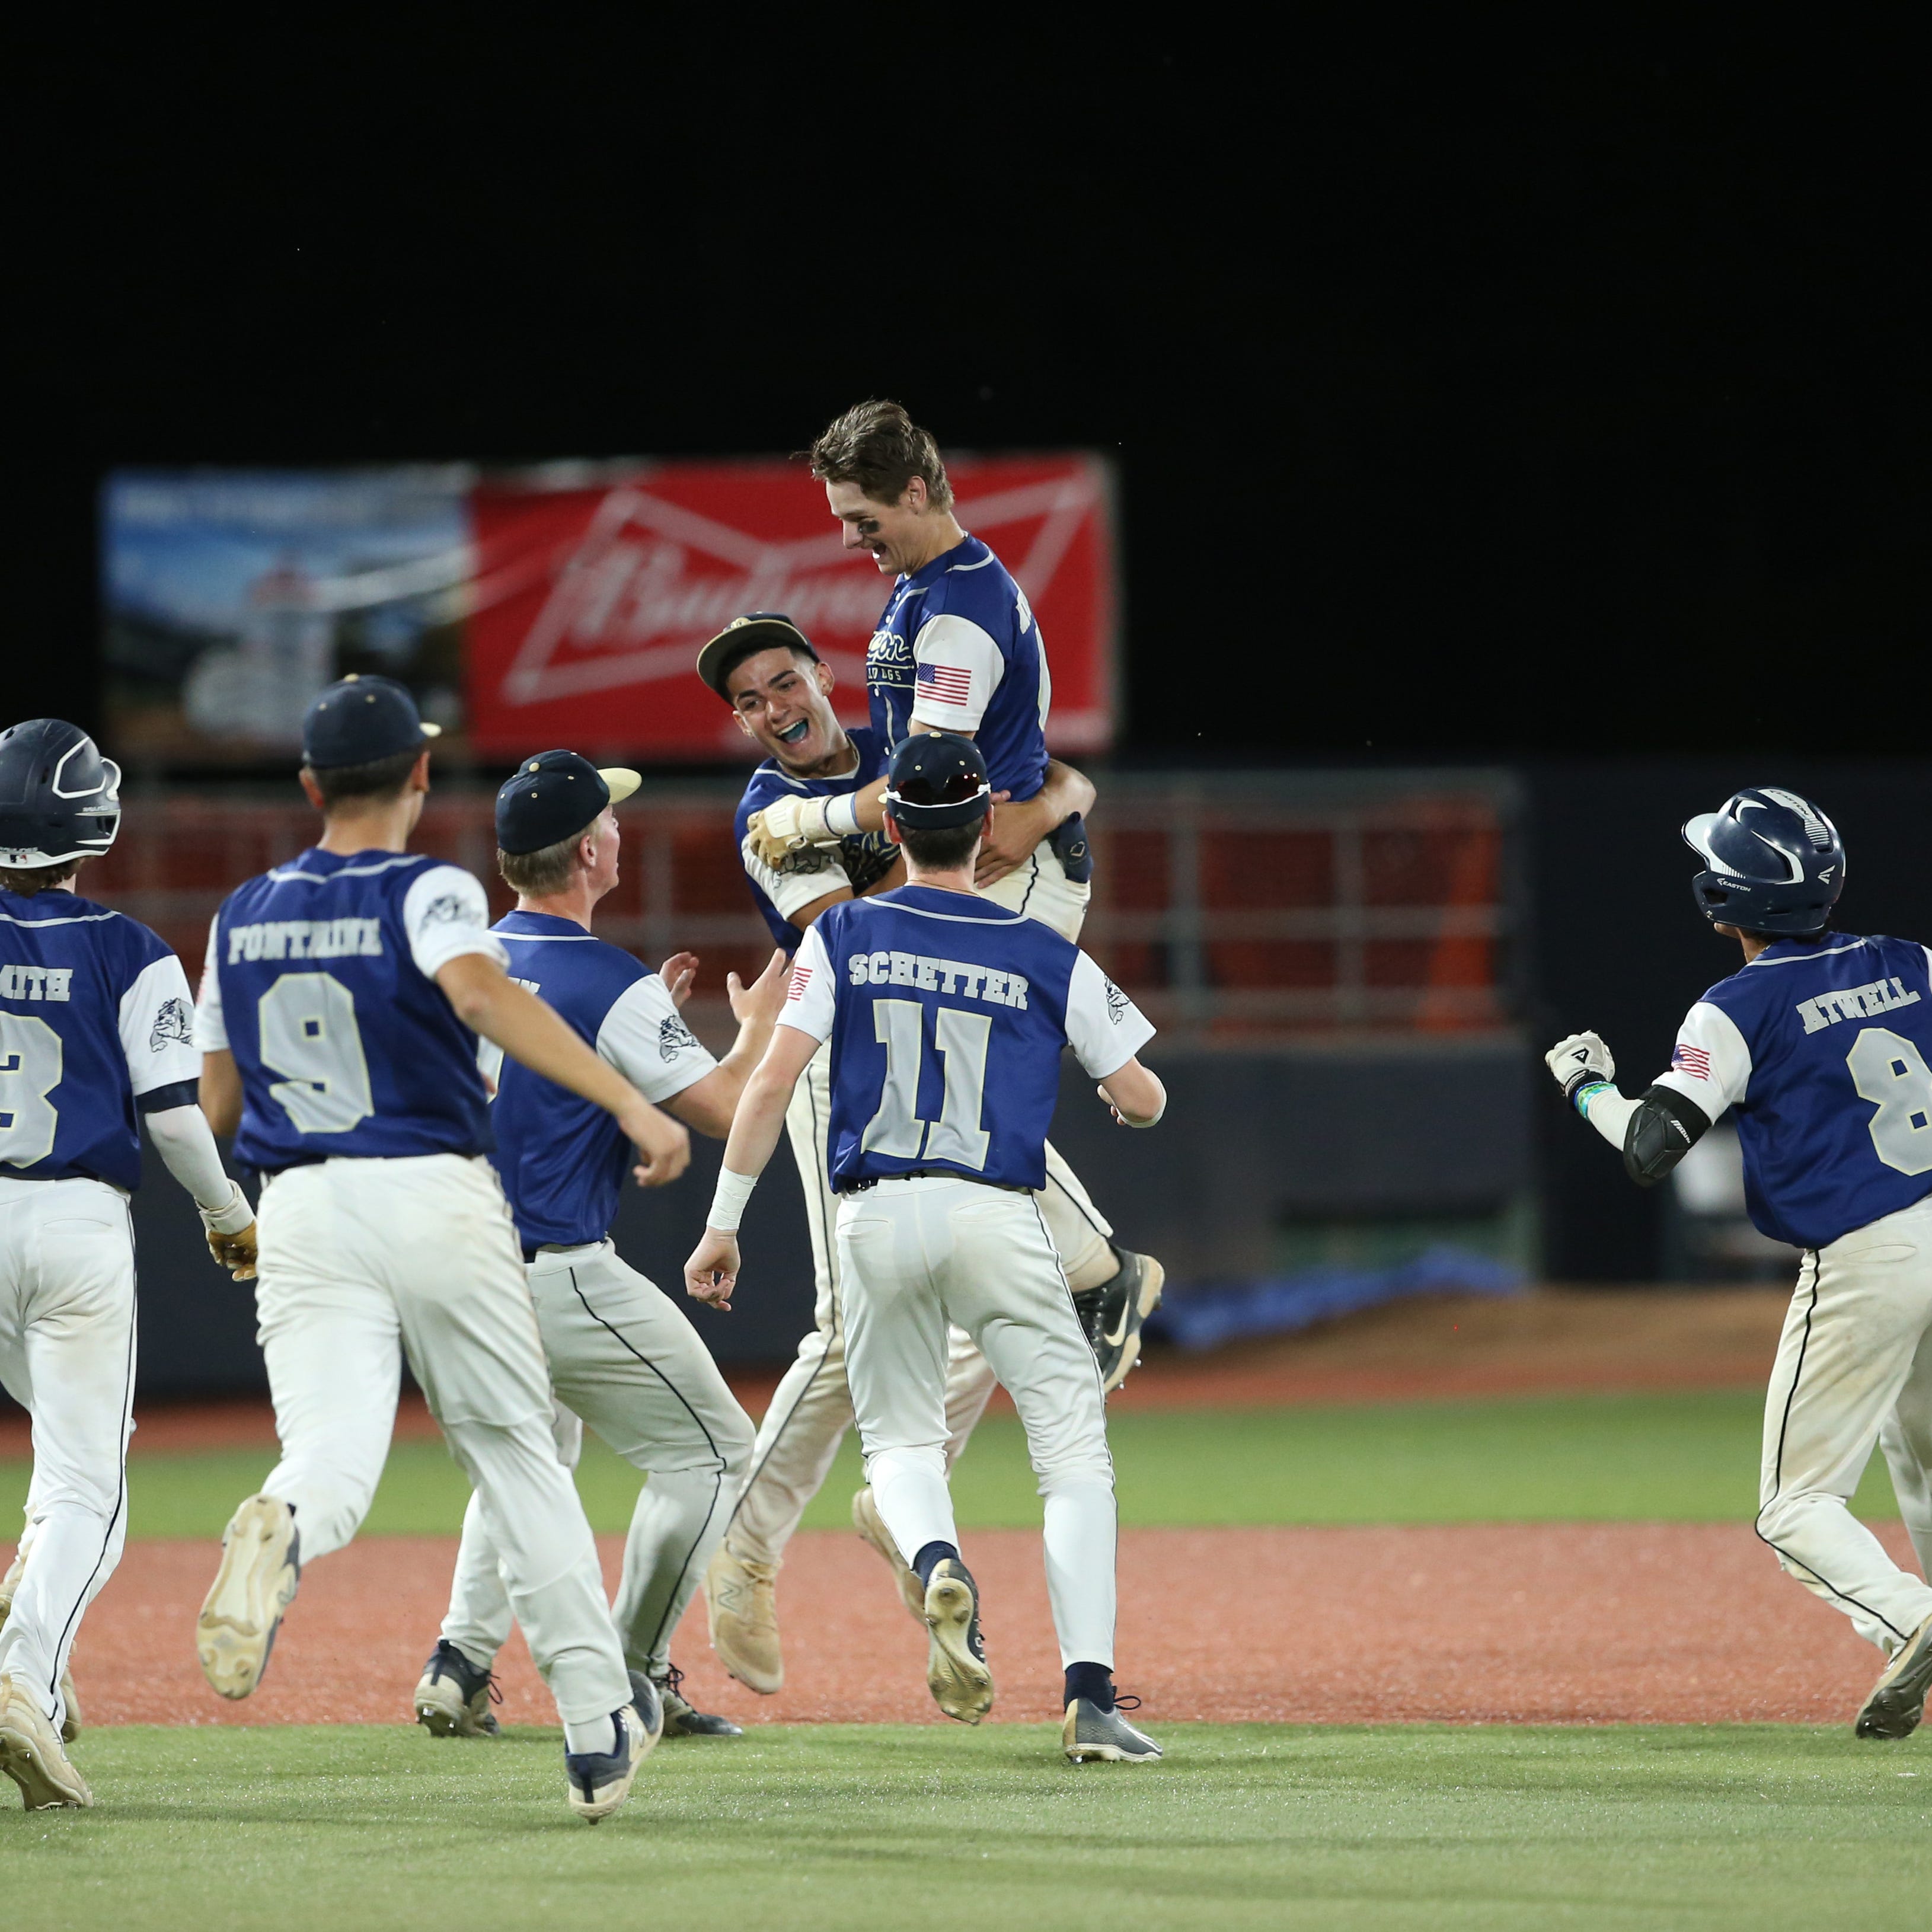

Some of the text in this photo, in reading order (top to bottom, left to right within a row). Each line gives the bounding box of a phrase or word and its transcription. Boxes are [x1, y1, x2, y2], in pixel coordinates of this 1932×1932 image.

[1723, 880, 1751, 892] EASTON
[228, 918, 383, 965] FONTAINE
[848, 951, 1029, 1010] SCHETTER
[1796, 976, 1921, 1035] ATWELL
[258, 972, 375, 1133] 9
[860, 998, 992, 1171] 11
[1845, 1027, 1932, 1176] 8
